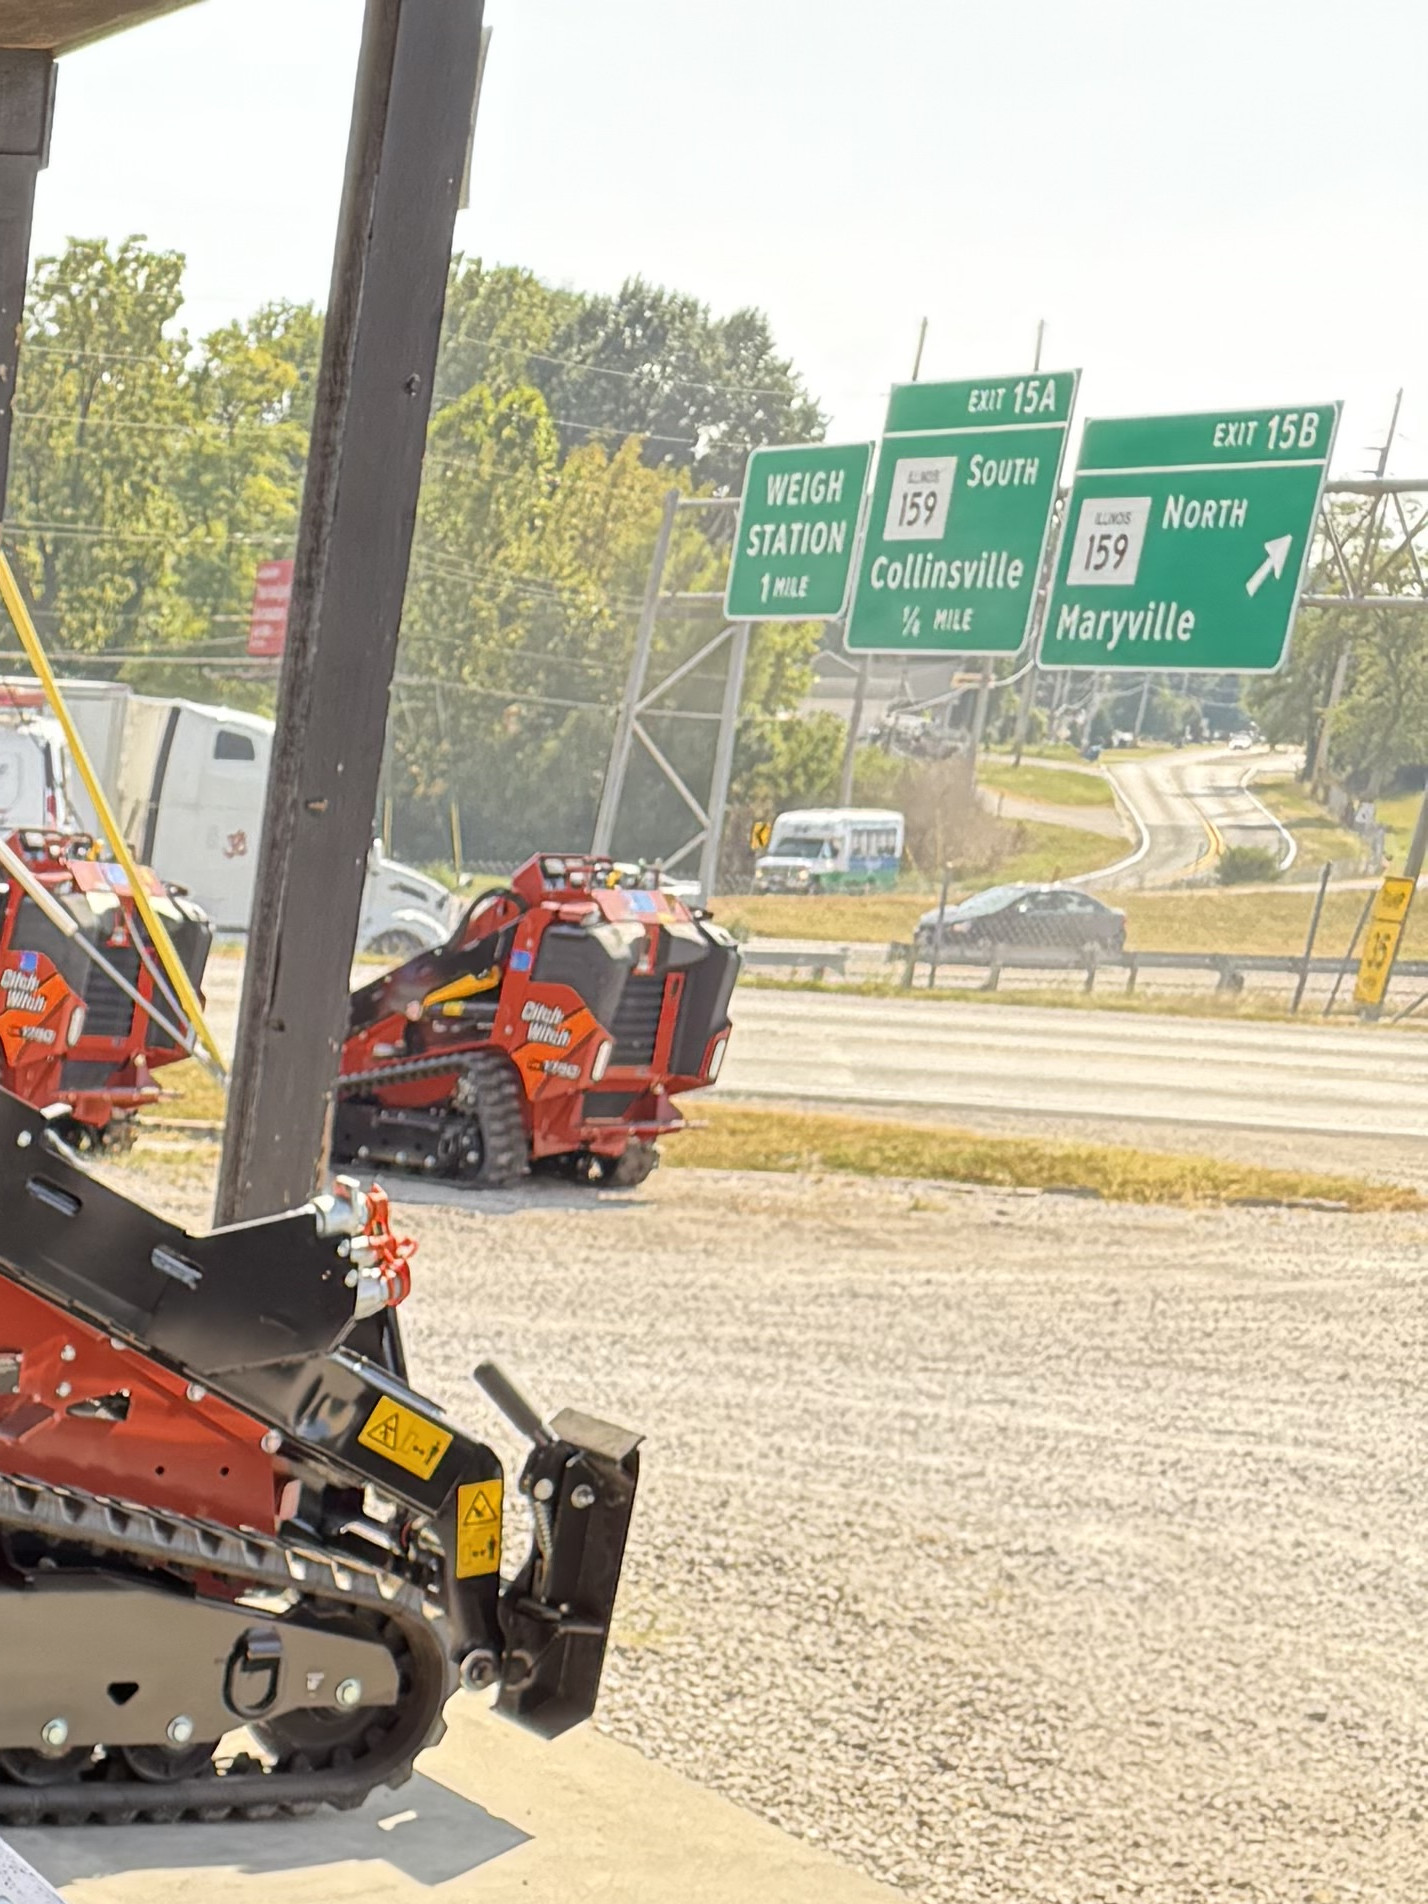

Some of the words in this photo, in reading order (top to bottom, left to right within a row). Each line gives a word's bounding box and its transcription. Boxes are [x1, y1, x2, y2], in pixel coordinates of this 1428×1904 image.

[968, 388, 1006, 413] EXIT
[1013, 379, 1056, 414] 15A
[1213, 421, 1258, 448] EXIT
[1267, 412, 1320, 450] 15B
[767, 469, 844, 506] WEIGH
[967, 454, 1039, 487] SOUTH
[898, 490, 937, 528] 159
[1095, 511, 1132, 526] ILLINOIS
[1162, 494, 1248, 529] NORTH
[746, 520, 847, 557] STATION
[1084, 533, 1129, 571] 159
[761, 572, 771, 603] 1
[773, 575, 810, 598] MILE
[870, 551, 1024, 590] Collinsville
[933, 607, 973, 631] MILE
[1056, 601, 1195, 651] Maryville
